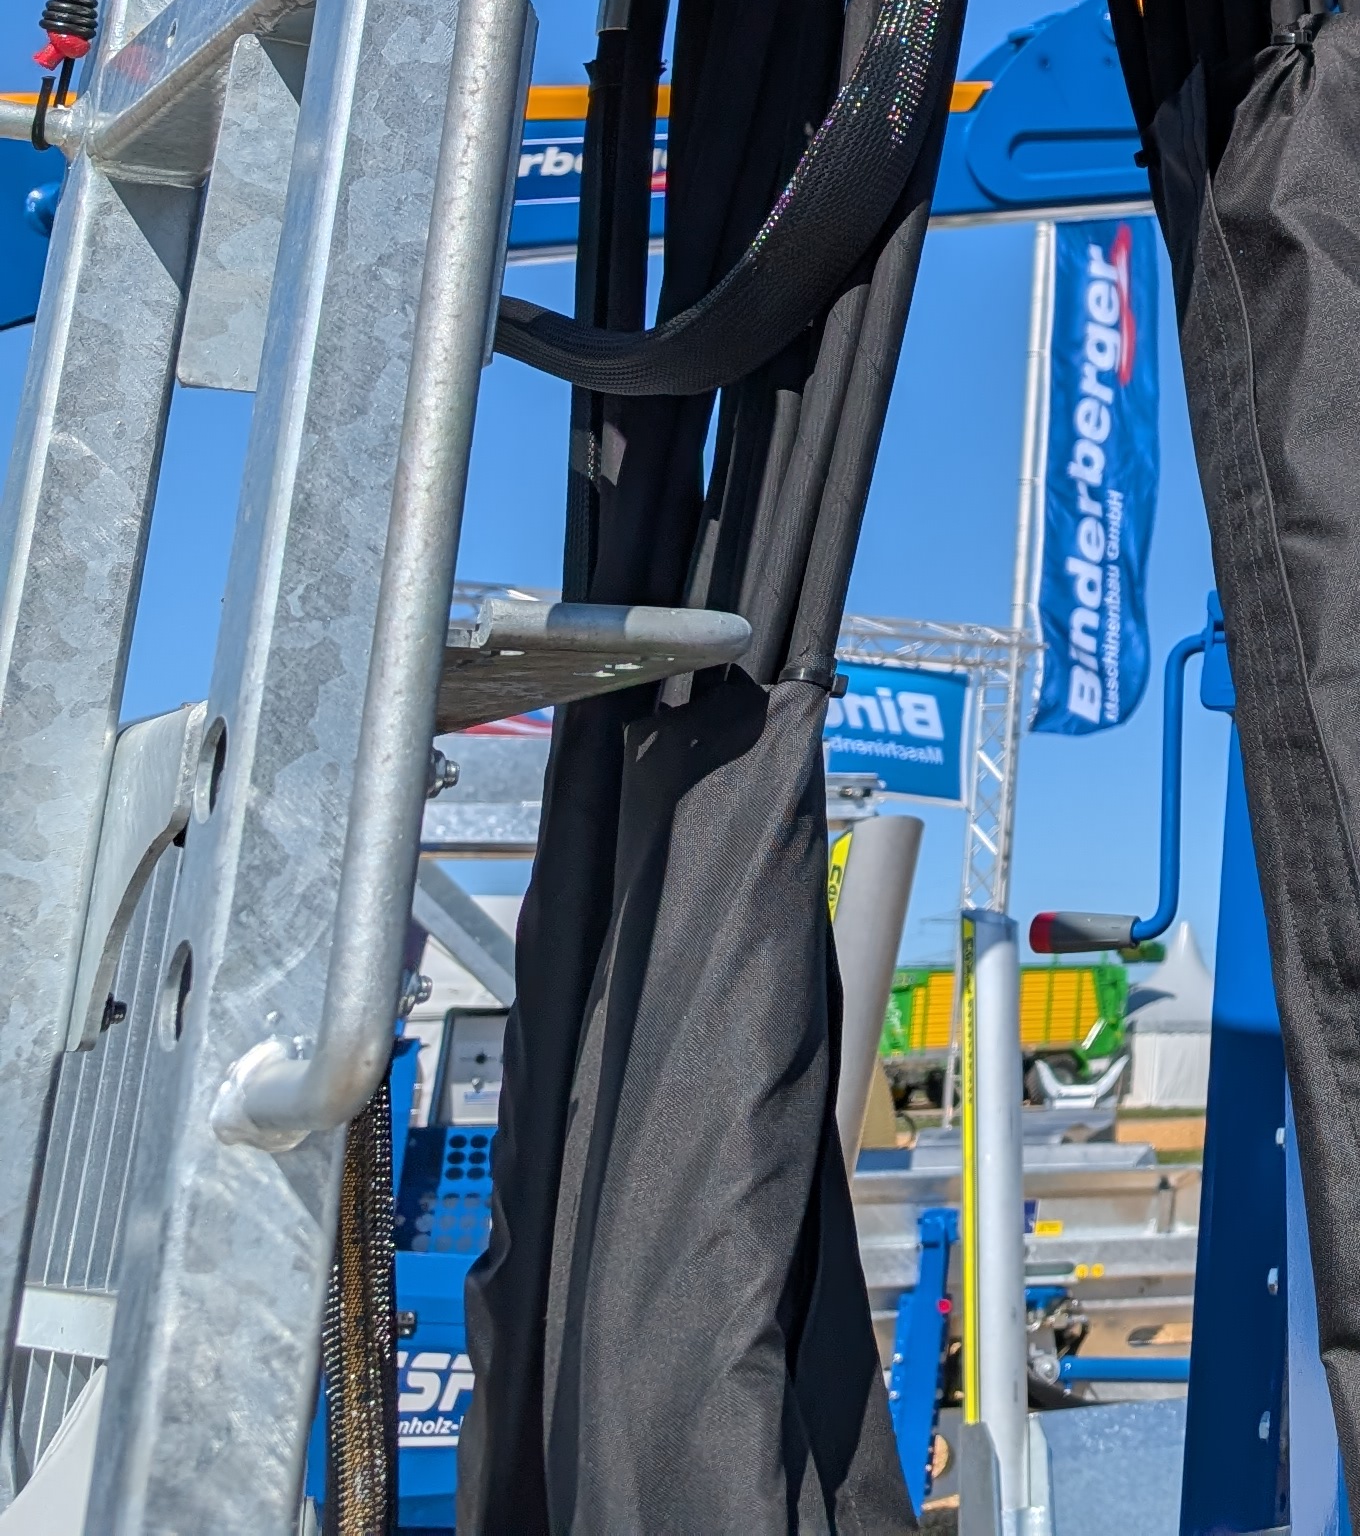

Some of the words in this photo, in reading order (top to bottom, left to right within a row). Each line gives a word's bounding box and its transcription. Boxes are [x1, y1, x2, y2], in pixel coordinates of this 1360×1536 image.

[1067, 243, 1121, 725] Binderberger
[1106, 490, 1123, 559] GmbH
[1101, 565, 1121, 721] Maschinenbau
